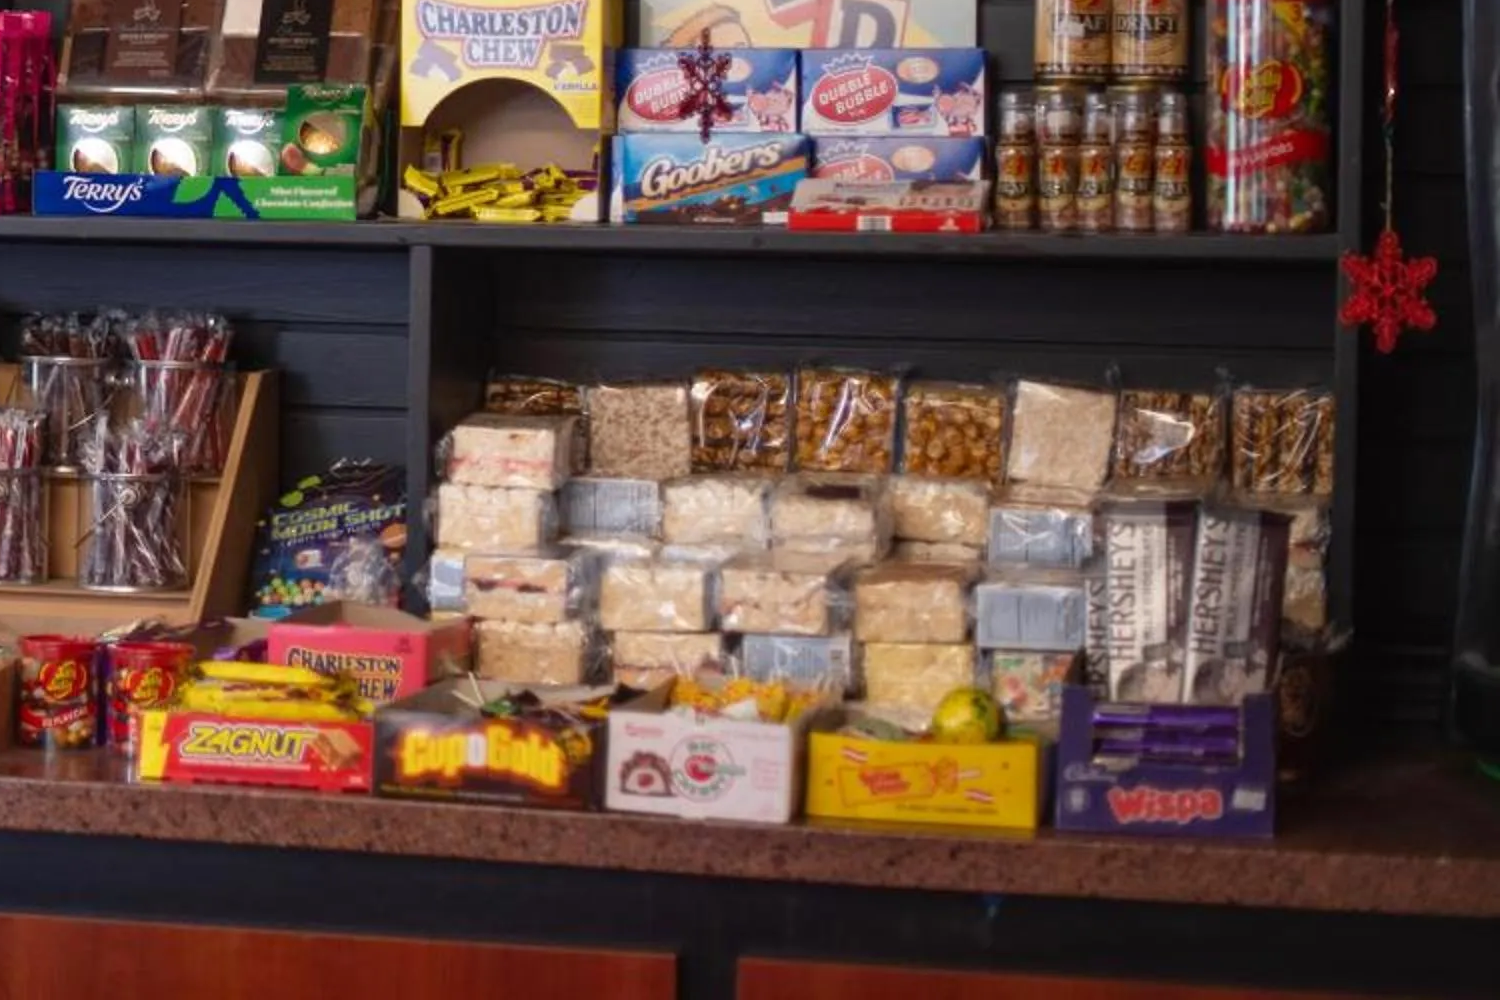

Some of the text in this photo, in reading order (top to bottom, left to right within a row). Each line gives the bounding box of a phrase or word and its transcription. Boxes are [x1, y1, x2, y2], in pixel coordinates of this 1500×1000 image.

[420, 0, 582, 37] CHARLESTON
[1116, 15, 1175, 33] DRAFT
[466, 38, 540, 65] CHEW
[819, 72, 872, 106] DUBBLE
[836, 82, 891, 117] BUBBLE
[643, 140, 783, 197] Goobers
[358, 679, 399, 701] HEW
[182, 723, 312, 760] ZAGNUT
[1108, 786, 1223, 824] Wispa
